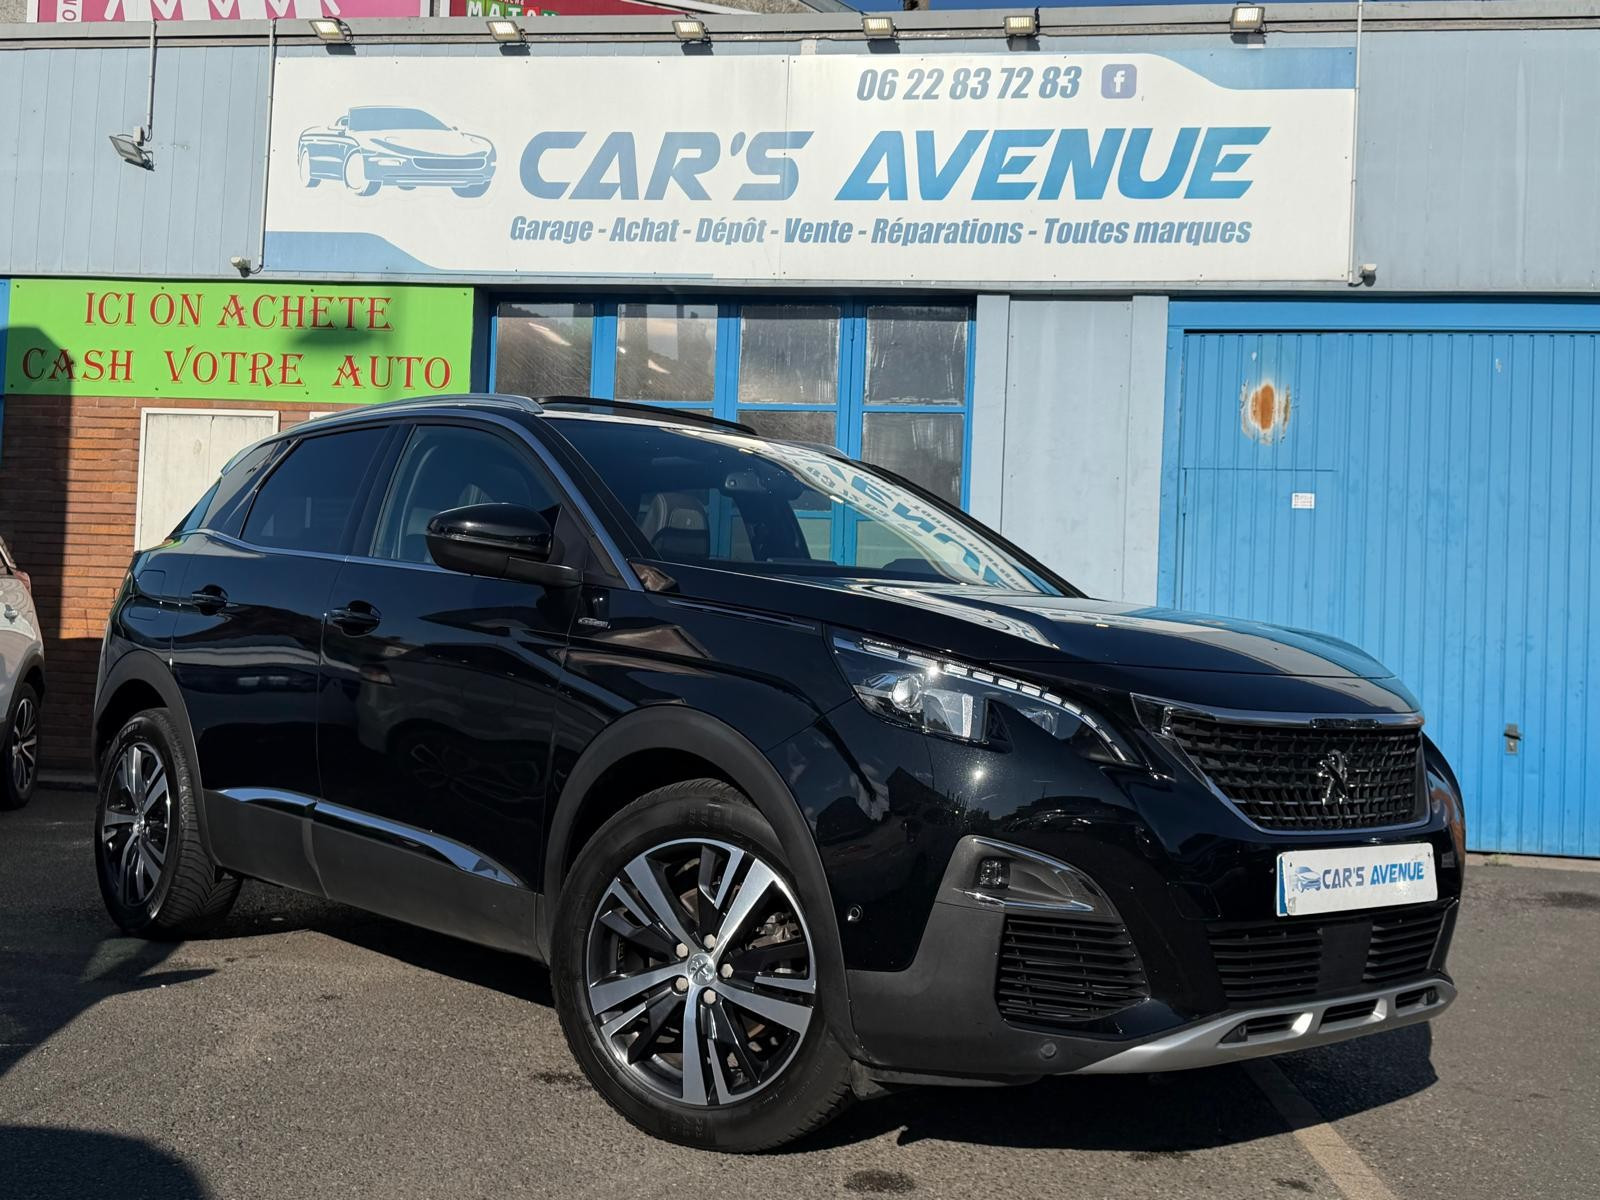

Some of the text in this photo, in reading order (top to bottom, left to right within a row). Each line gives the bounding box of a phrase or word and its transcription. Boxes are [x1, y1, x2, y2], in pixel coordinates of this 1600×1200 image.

[857, 66, 1082, 100] 06 22 83 72 83
[519, 127, 1271, 201] CAR'S AVENUE
[510, 216, 593, 244] Garage
[609, 217, 679, 242] Achat
[695, 217, 767, 245] Dépôt
[784, 218, 853, 243] Vente
[871, 217, 1024, 246] Réparations
[1044, 218, 1128, 245] Toutes
[1133, 221, 1253, 246] marques
[84, 292, 393, 332] ICI ON ACHETE
[22, 343, 453, 390] CASH VOTRE AUTO
[1322, 861, 1424, 890] CAR'S AVENUE
